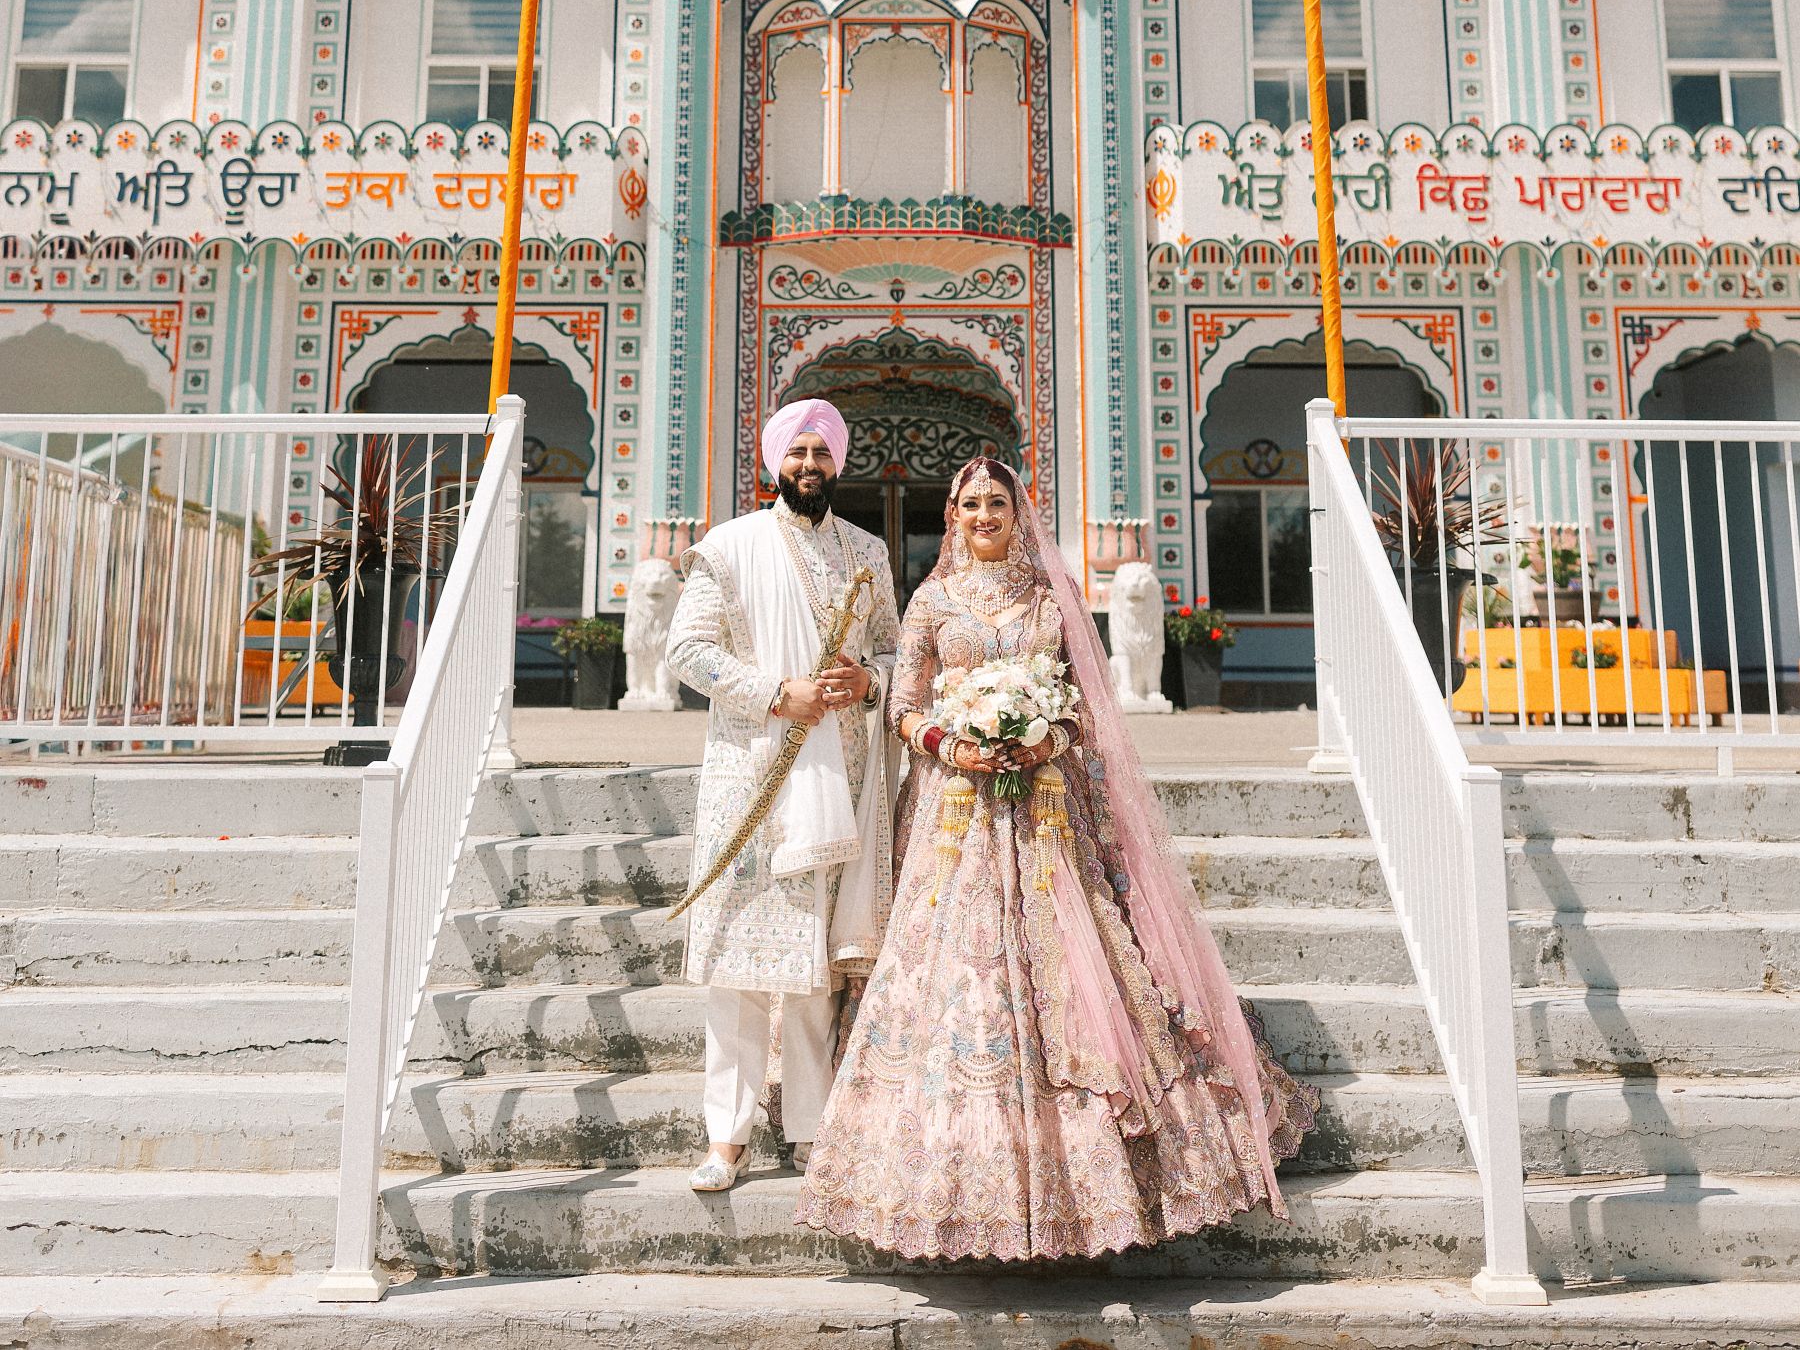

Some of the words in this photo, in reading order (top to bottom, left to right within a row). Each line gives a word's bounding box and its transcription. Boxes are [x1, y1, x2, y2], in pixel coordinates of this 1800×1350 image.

[116, 160, 194, 226] ਅਤਿ
[220, 158, 300, 225] ਊਚਾ
[326, 173, 408, 210] ਤਾਕਾ
[1218, 163, 1286, 221] ਅੰਤੁ
[1515, 177, 1682, 213] ਪਾਰਾਵਾਰਾ
